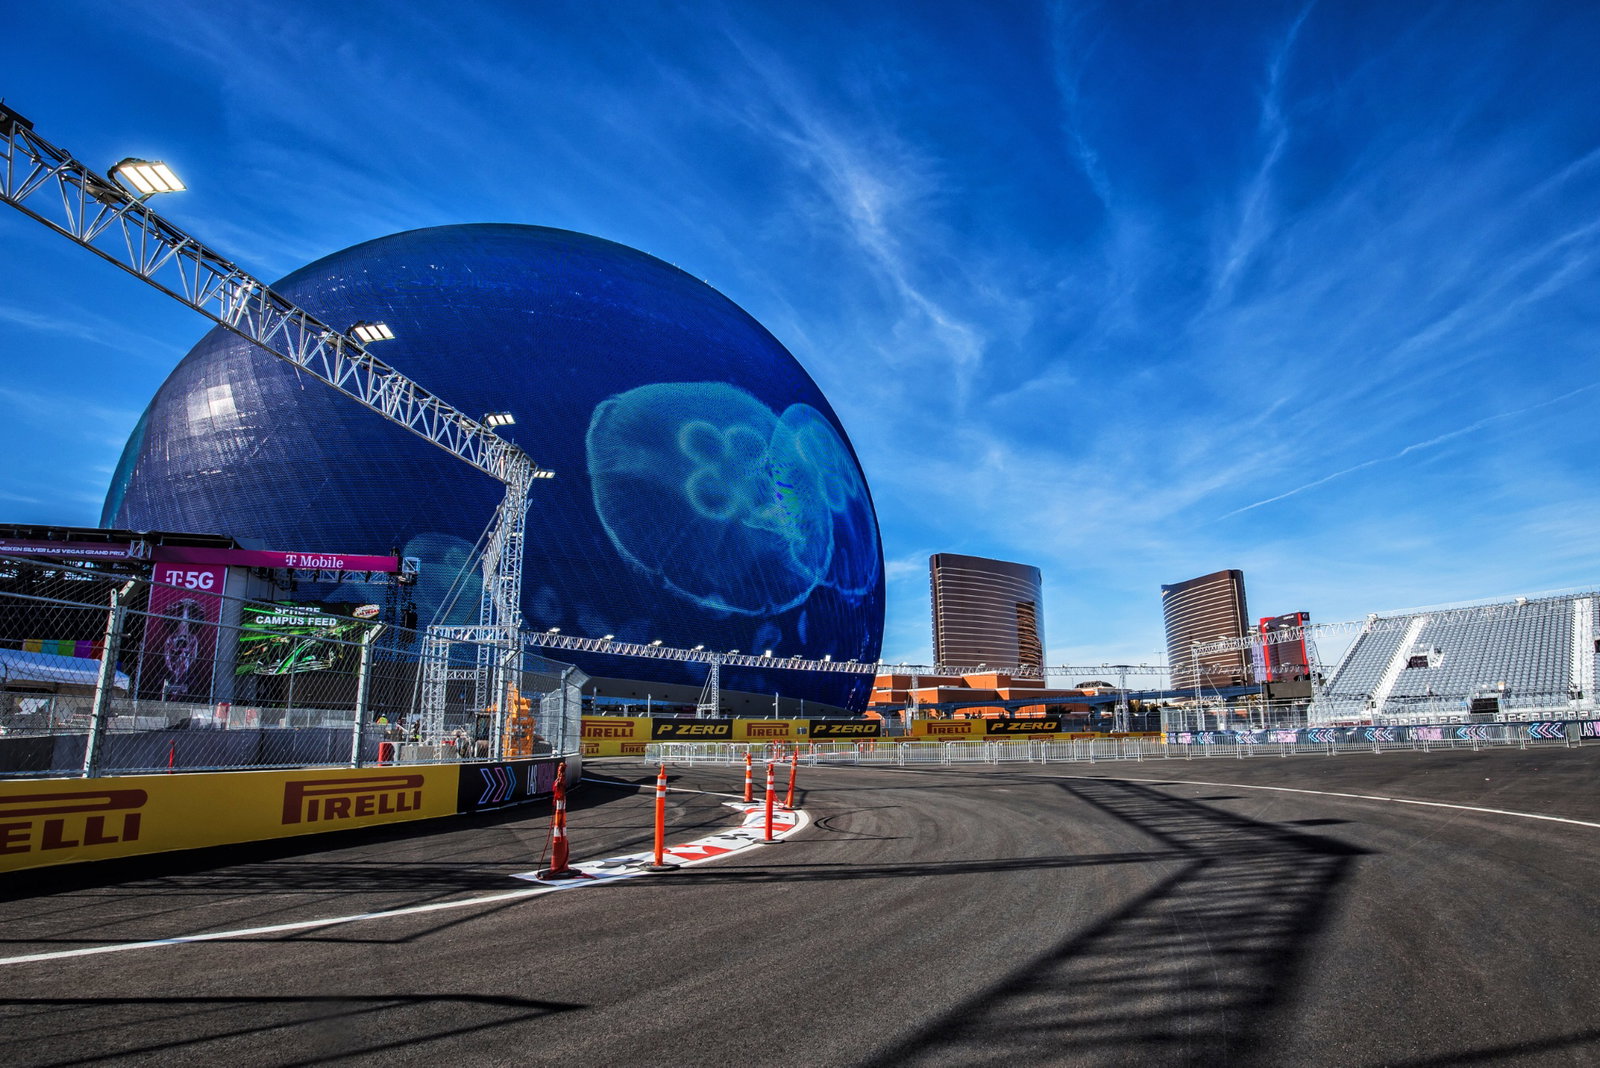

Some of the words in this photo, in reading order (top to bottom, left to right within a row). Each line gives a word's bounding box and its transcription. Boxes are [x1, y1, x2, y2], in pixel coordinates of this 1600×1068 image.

[300, 555, 344, 568] Mobile
[256, 616, 305, 625] CAMPUS
[307, 617, 337, 626] FEED
[657, 724, 673, 735] P
[675, 724, 729, 735] ZERO
[747, 722, 790, 737] PIRELLI
[813, 725, 827, 734] P
[829, 724, 878, 733] ZERO
[927, 722, 971, 734] PIRELLI
[991, 722, 1005, 731] P
[1007, 722, 1058, 731] ZERO
[282, 774, 425, 825] PIRELLI
